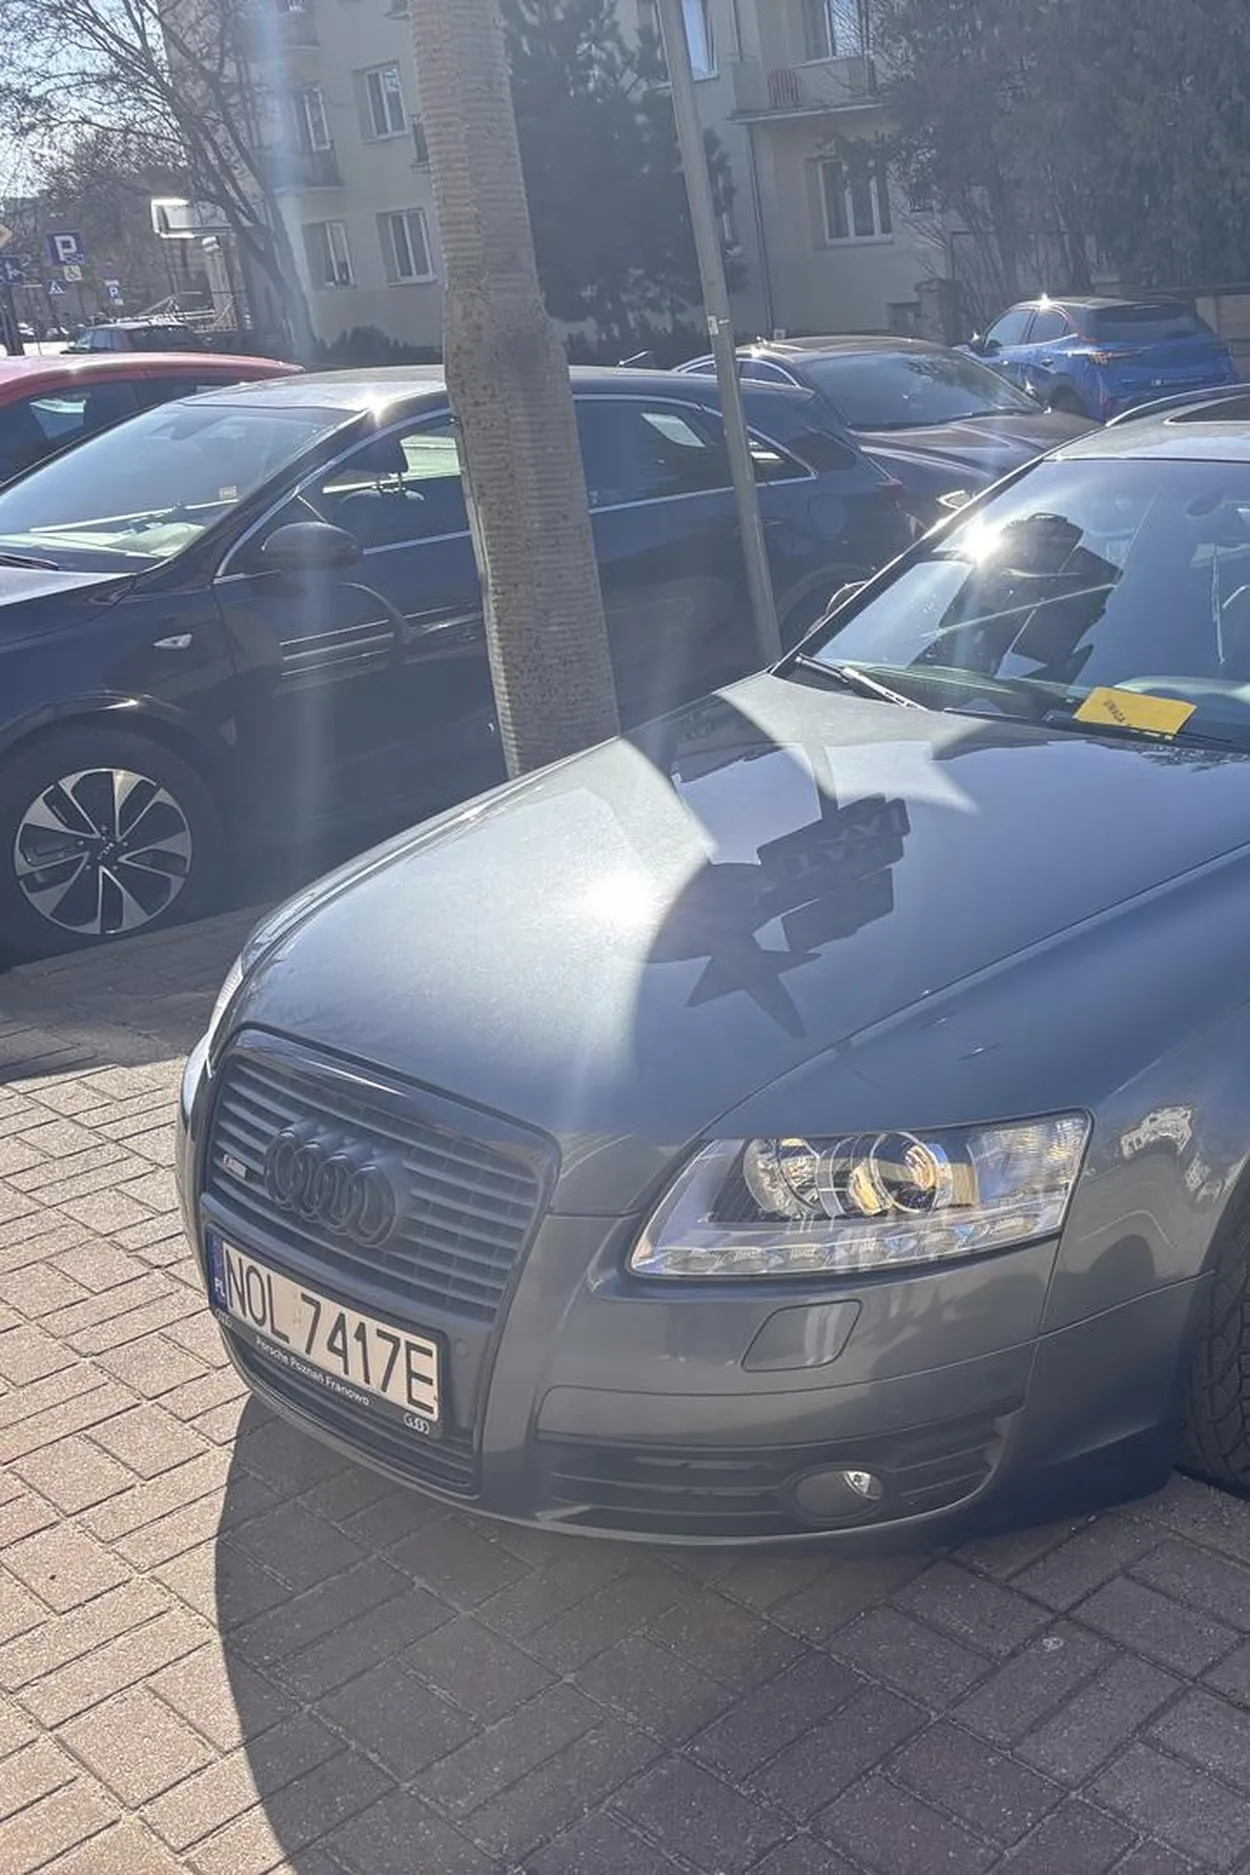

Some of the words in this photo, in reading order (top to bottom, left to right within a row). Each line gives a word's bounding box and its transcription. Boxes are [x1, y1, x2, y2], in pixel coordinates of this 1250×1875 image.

[54, 235, 77, 261] P
[108, 286, 119, 297] P
[214, 1276, 226, 1298] PL
[225, 1249, 290, 1344] NOL
[301, 1292, 436, 1414] 7417E
